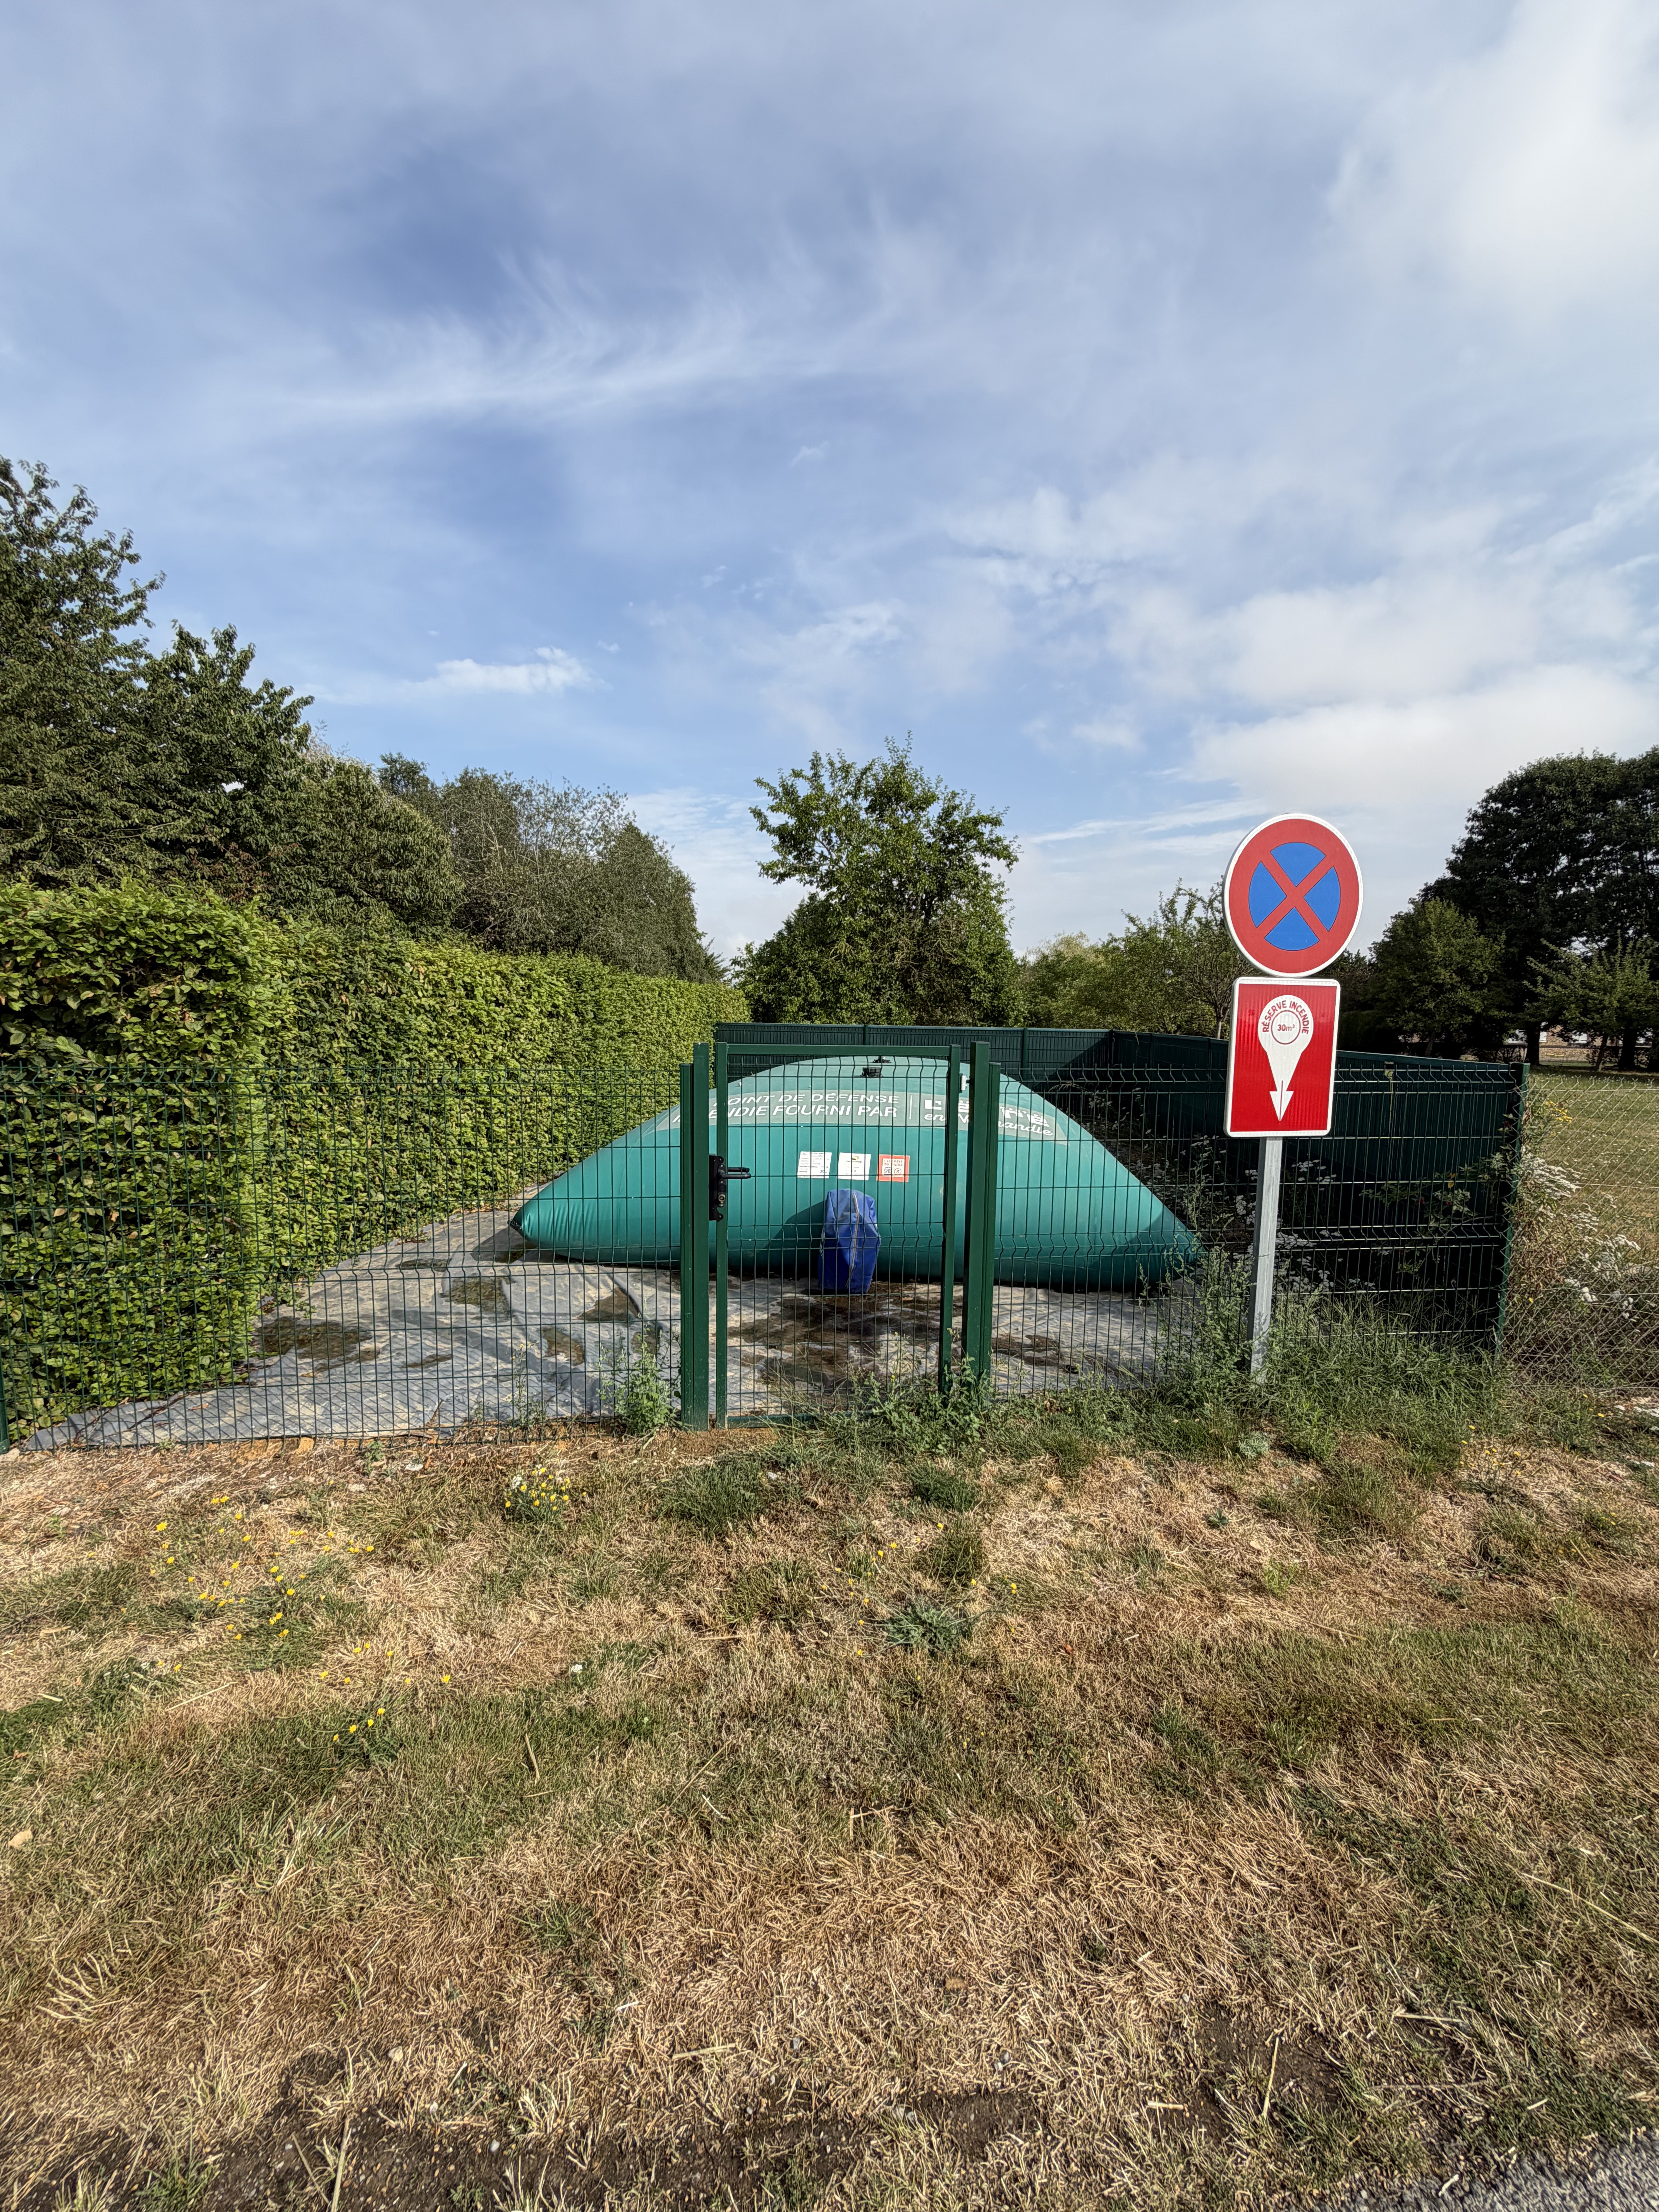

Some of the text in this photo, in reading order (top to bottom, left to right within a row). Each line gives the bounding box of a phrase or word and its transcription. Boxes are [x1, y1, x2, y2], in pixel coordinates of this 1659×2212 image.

[1261, 1000, 1309, 1034] RÉSERVE INCENDIE
[713, 1095, 775, 1106] OINT
[810, 1093, 899, 1103] DÉFENSE
[773, 1105, 851, 1115] FOURNI
[857, 1106, 897, 1117] PAR
